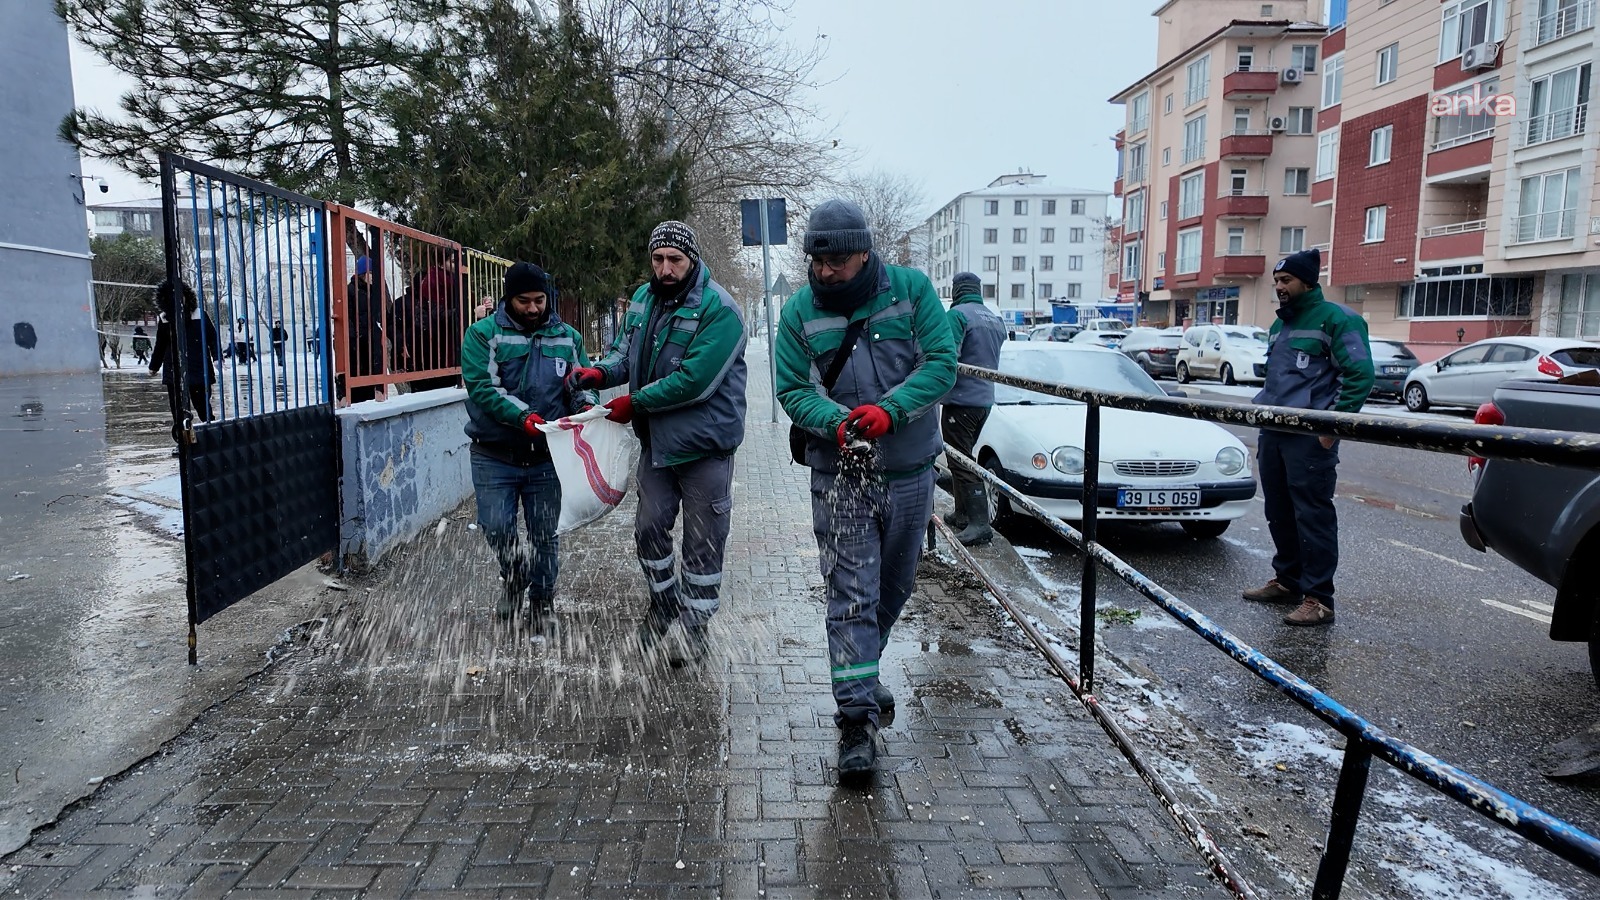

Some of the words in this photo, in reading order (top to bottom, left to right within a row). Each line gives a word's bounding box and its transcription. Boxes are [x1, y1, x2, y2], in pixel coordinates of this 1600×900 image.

[1125, 492, 1142, 505] 39
[1149, 492, 1166, 505] LS
[1172, 492, 1198, 505] 059
